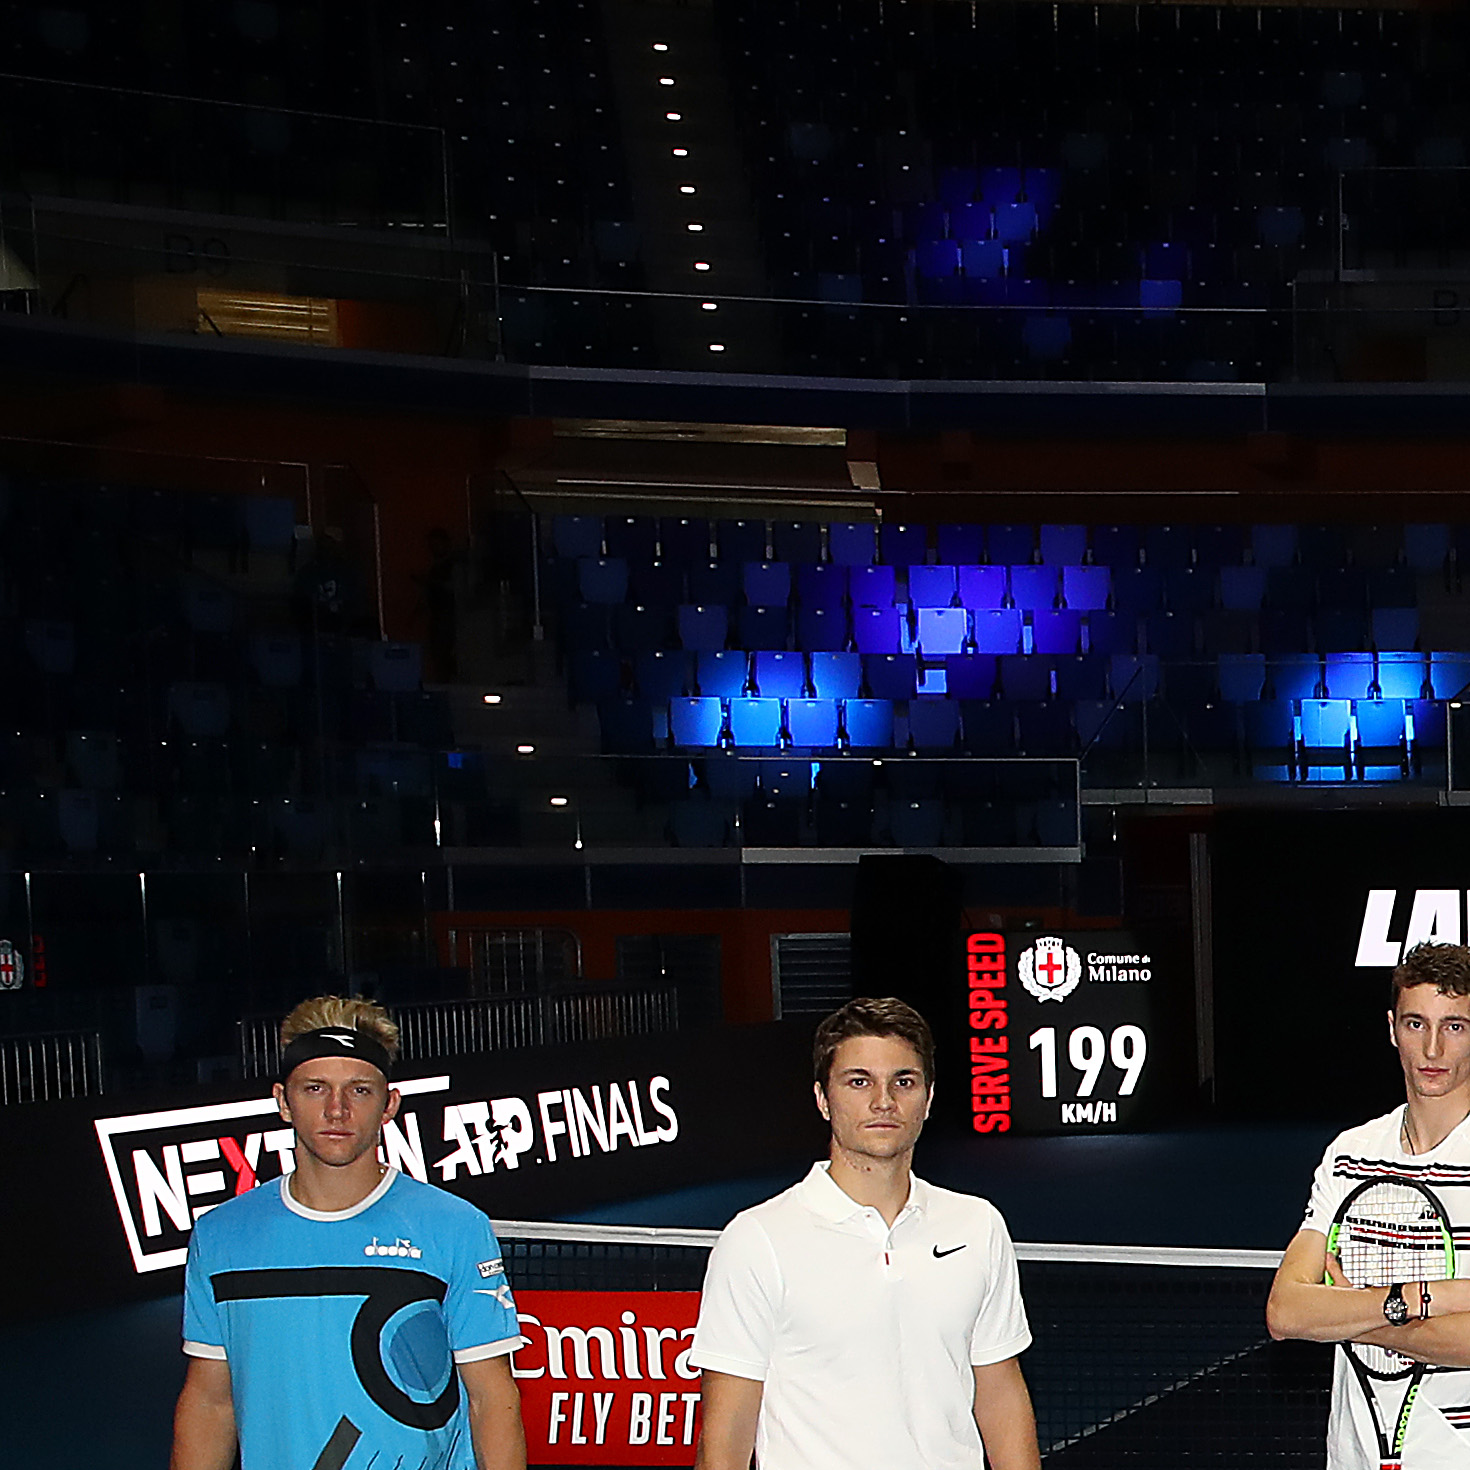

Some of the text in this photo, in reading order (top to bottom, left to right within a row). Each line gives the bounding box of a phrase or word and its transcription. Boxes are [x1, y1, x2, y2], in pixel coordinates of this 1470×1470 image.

[965, 931, 1008, 1030] SPEED
[1087, 952, 1140, 965] Comune
[1088, 966, 1153, 983] Milano
[968, 1034, 1012, 1134] SERVE
[1028, 1023, 1149, 1099] 199
[538, 1076, 680, 1165] FINALS
[1061, 1100, 1118, 1124] KM/H
[548, 1392, 702, 1446] FLY BET
